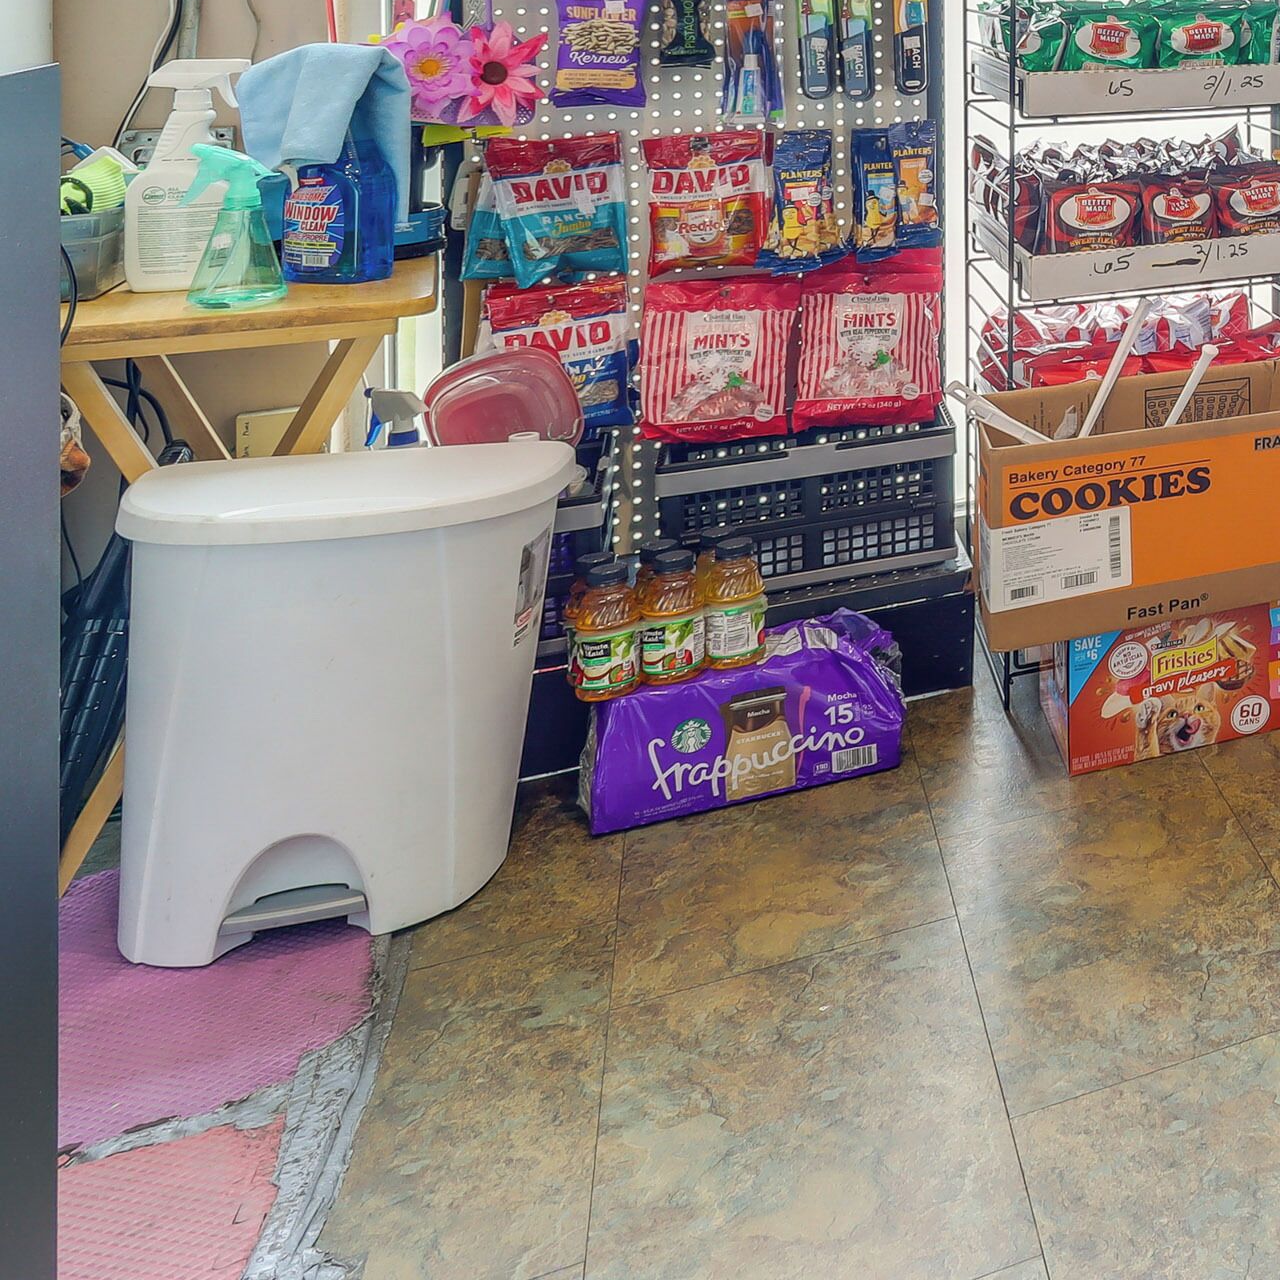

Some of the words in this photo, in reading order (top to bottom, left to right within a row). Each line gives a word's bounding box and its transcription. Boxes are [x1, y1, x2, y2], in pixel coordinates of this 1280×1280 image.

[569, 51, 629, 65] Kernels
[892, 146, 933, 157] PLANTERS
[511, 171, 609, 204] DAVID
[652, 164, 751, 195] DAVID
[285, 201, 339, 221] WINDOW
[300, 221, 326, 232] CLEAN
[552, 220, 592, 235] Jumbo
[843, 311, 897, 329] MINTS
[692, 332, 751, 350] MINTS
[1008, 467, 1058, 485] Bakery
[1063, 459, 1126, 476] Category
[1130, 455, 1146, 466] 77
[1009, 466, 1211, 520] COOKIES
[1127, 601, 1165, 621] Fast
[1074, 636, 1101, 652] SAVE
[1156, 650, 1214, 674] Friskies
[1142, 679, 1174, 699] gravy
[1177, 666, 1232, 690] pleasers
[827, 691, 858, 703] Mocha
[823, 703, 855, 726] 15
[1240, 702, 1262, 718] 60
[1238, 718, 1261, 726] CANS
